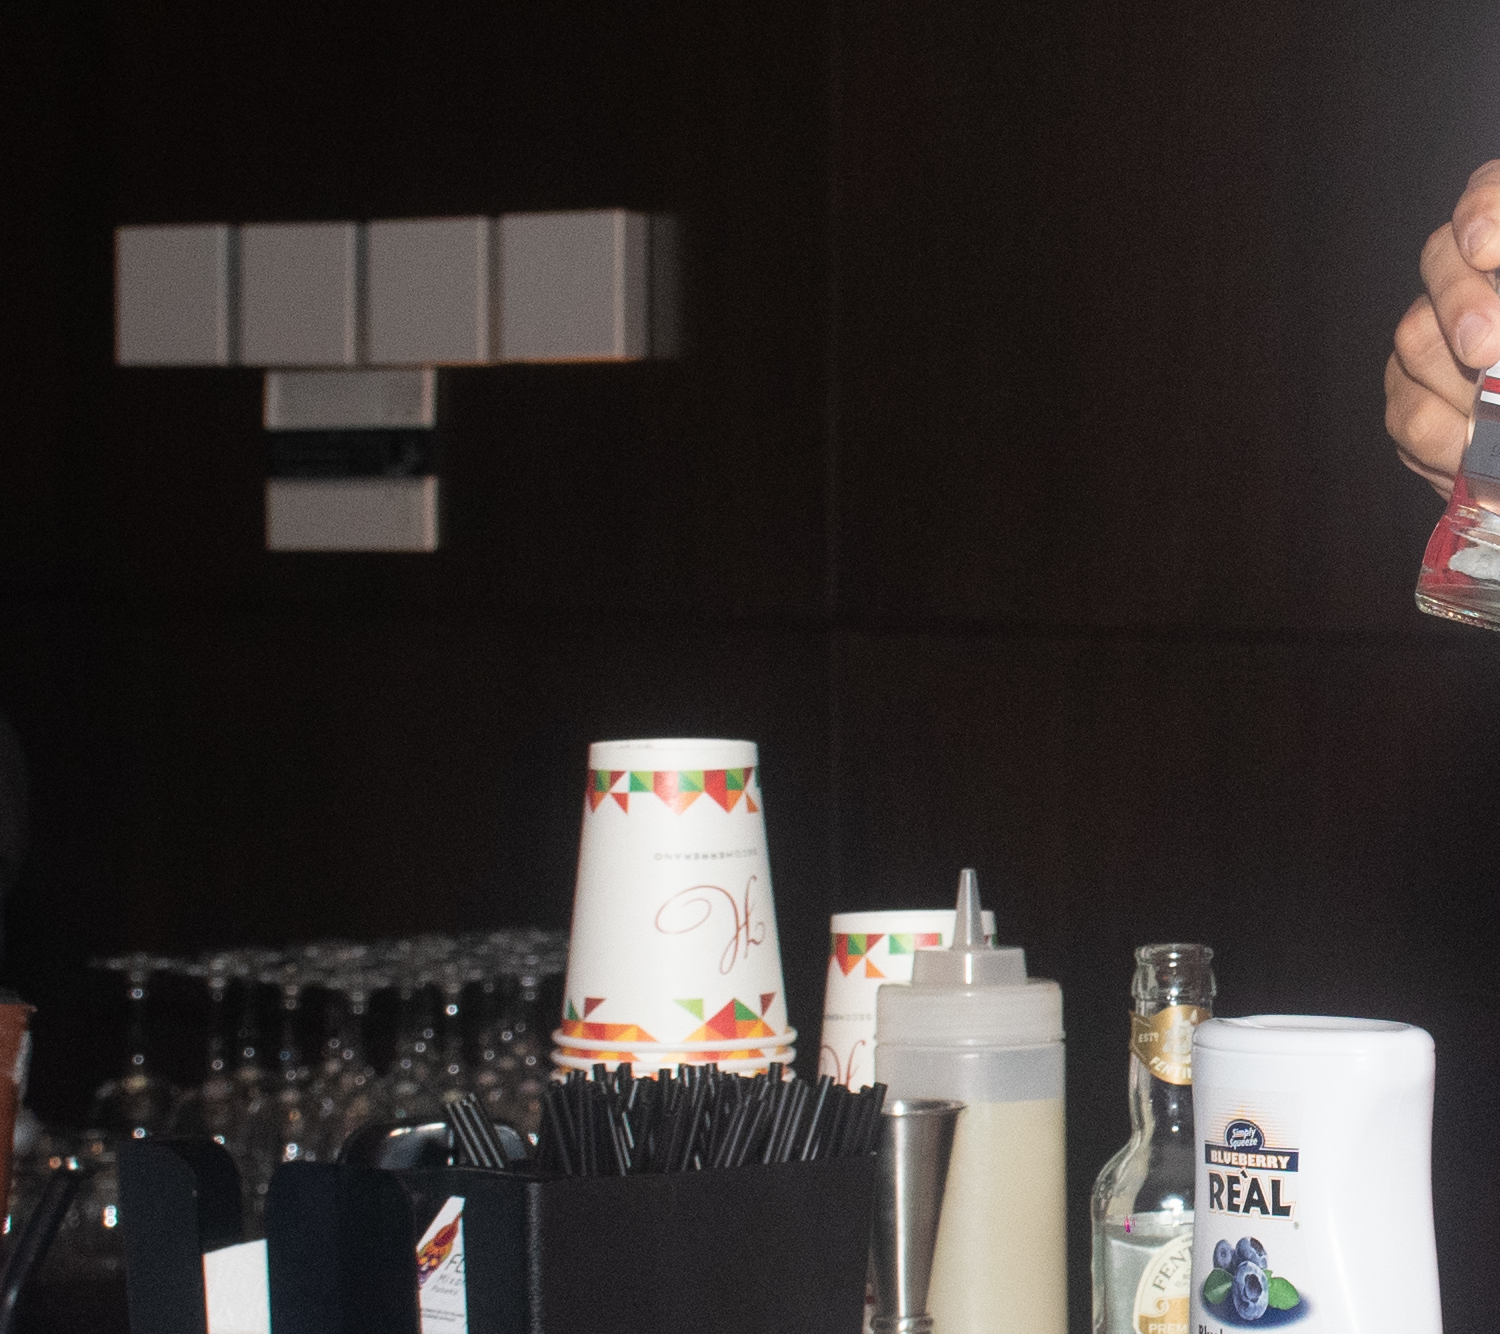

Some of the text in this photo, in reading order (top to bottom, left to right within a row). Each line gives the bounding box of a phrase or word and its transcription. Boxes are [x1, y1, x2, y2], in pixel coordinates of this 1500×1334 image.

[1231, 1127, 1257, 1140] Simply
[1229, 1137, 1258, 1150] Squeeze
[1209, 1149, 1291, 1170] BLUEBERRY
